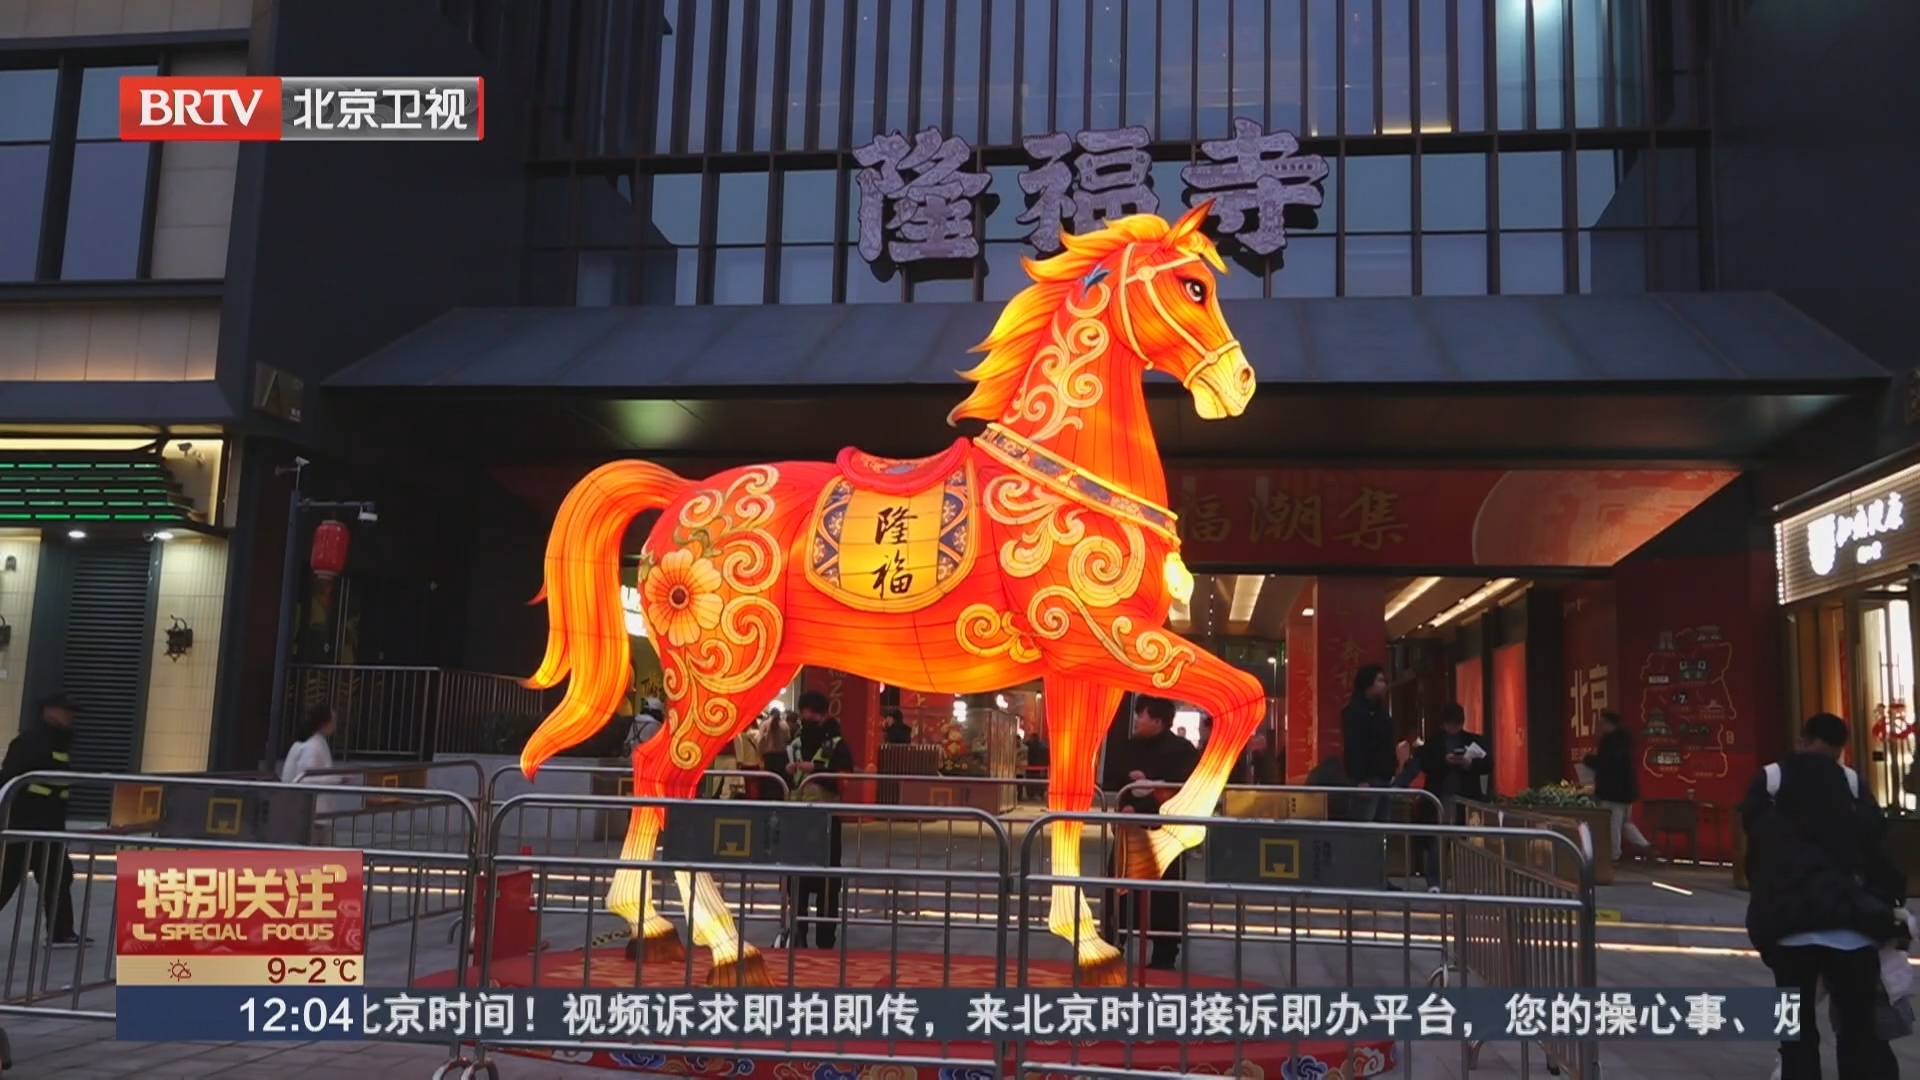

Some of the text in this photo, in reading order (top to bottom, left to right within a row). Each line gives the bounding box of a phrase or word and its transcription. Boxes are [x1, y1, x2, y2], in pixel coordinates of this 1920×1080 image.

[853, 116, 1330, 262] 隆福寺
[872, 506, 918, 599] 隆福
